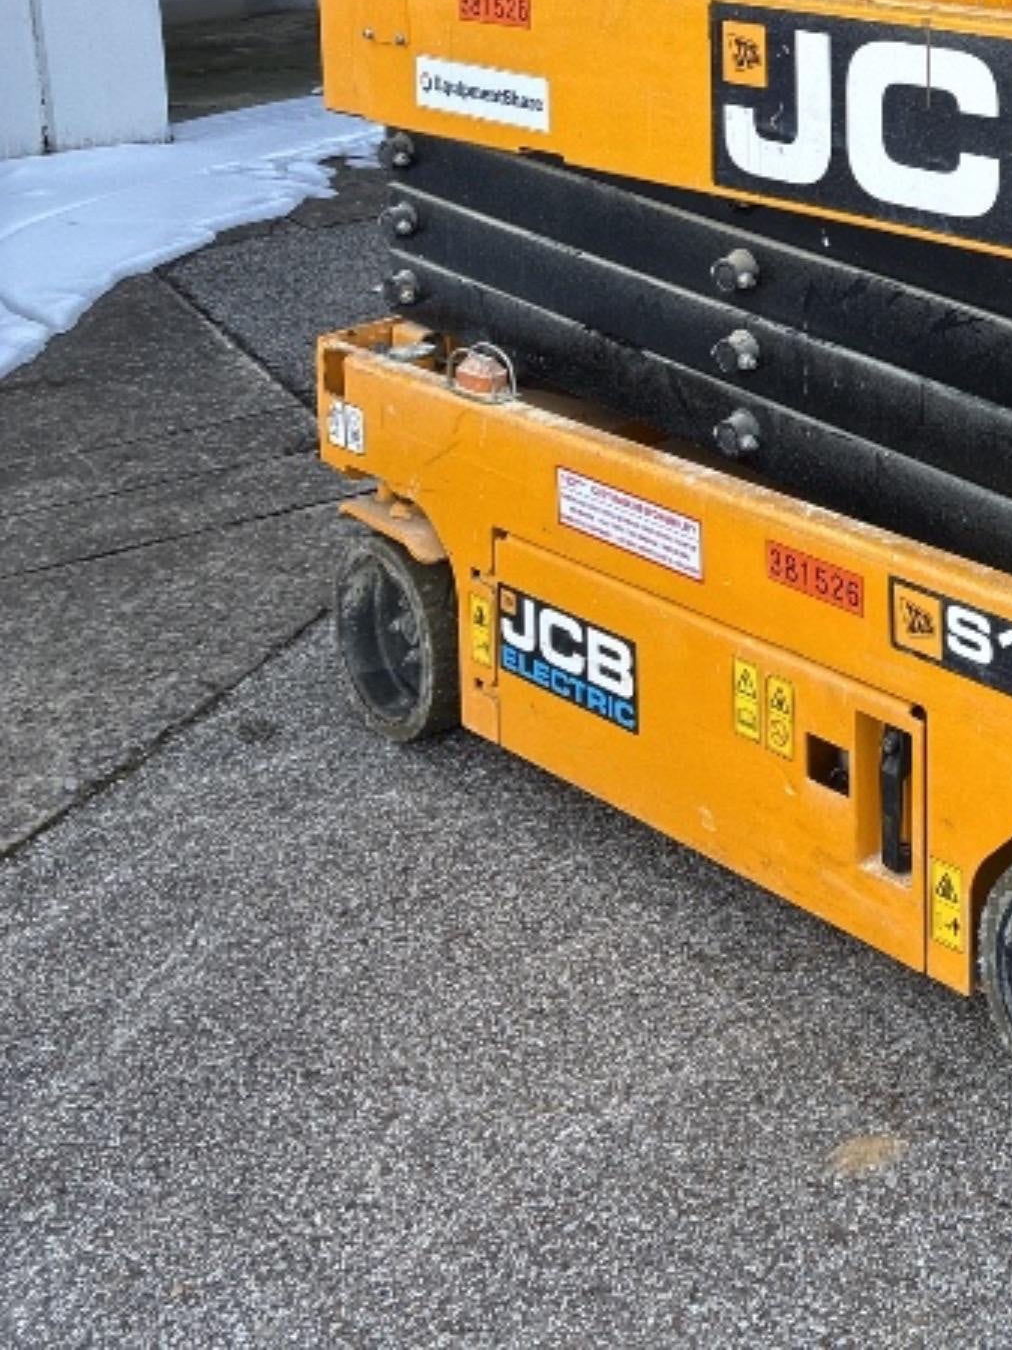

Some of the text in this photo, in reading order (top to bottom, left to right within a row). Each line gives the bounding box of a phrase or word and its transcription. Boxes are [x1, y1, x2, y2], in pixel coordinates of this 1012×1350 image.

[770, 548, 859, 607] 381526
[501, 598, 634, 700] JCB
[502, 644, 637, 730] ELECTRIC
